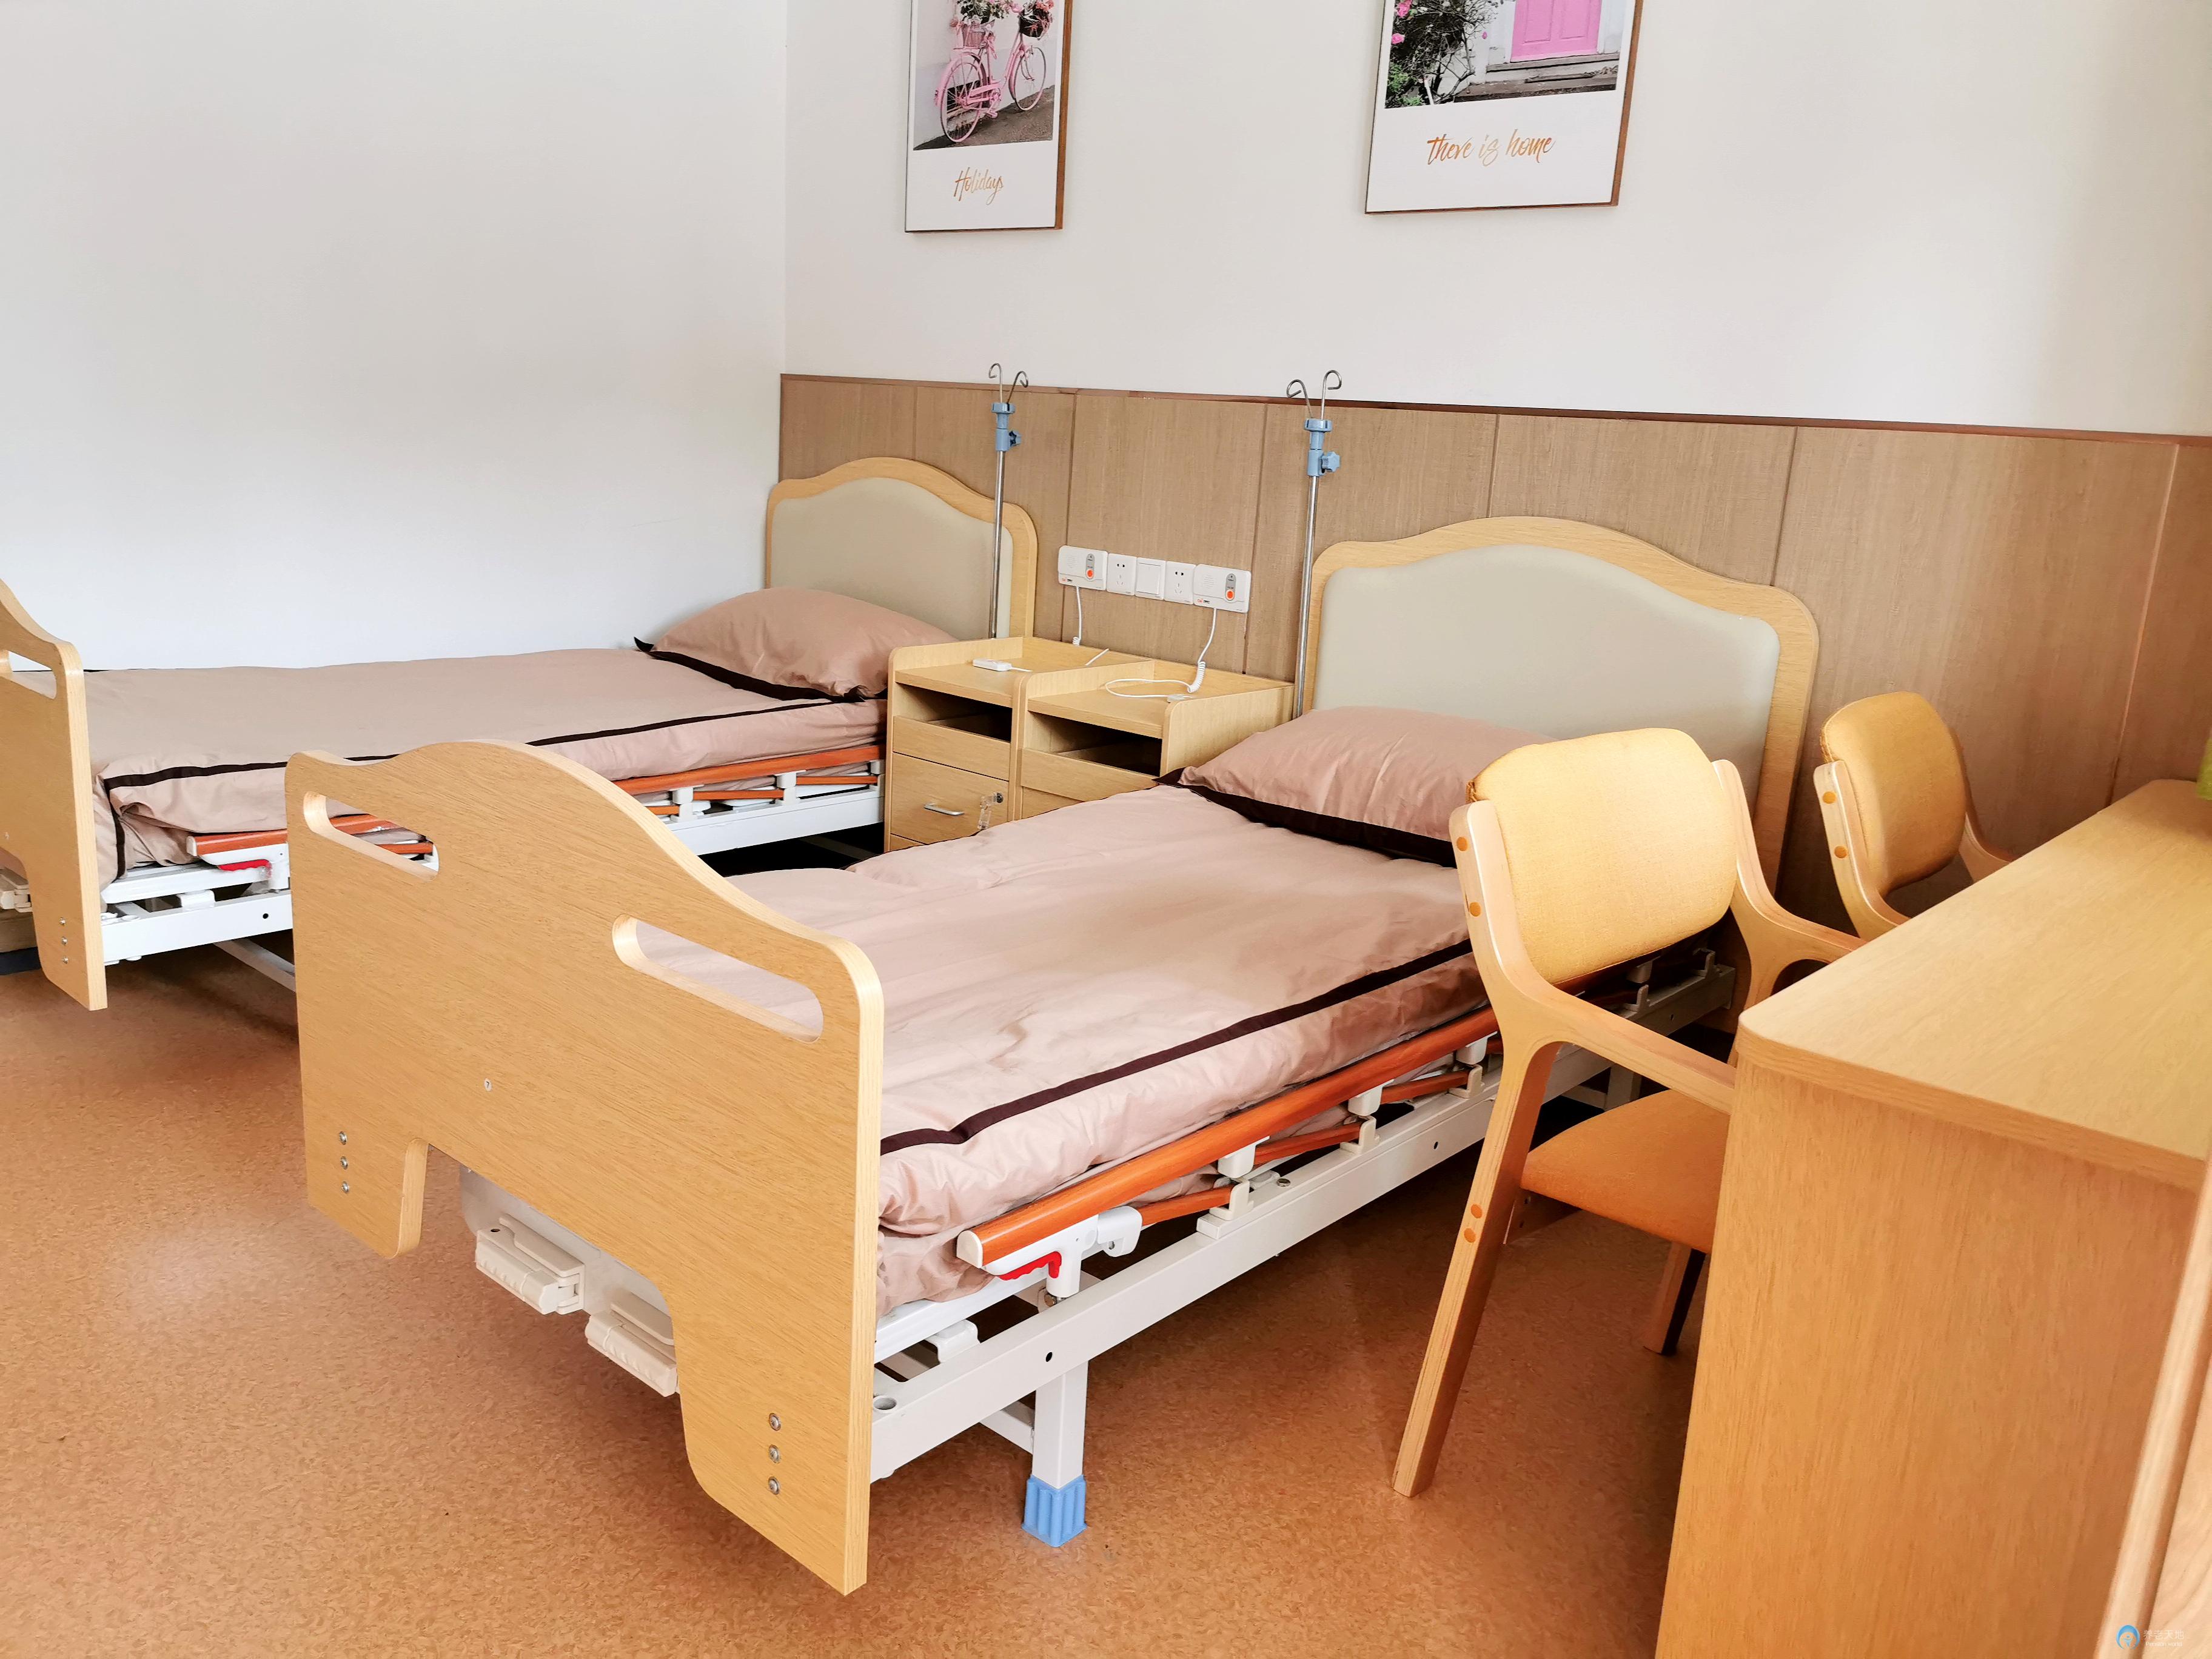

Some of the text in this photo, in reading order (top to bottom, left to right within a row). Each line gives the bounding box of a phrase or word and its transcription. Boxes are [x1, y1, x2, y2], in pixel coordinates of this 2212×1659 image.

[1427, 129, 1556, 167] there is home
[953, 167, 1004, 206] Holidays
